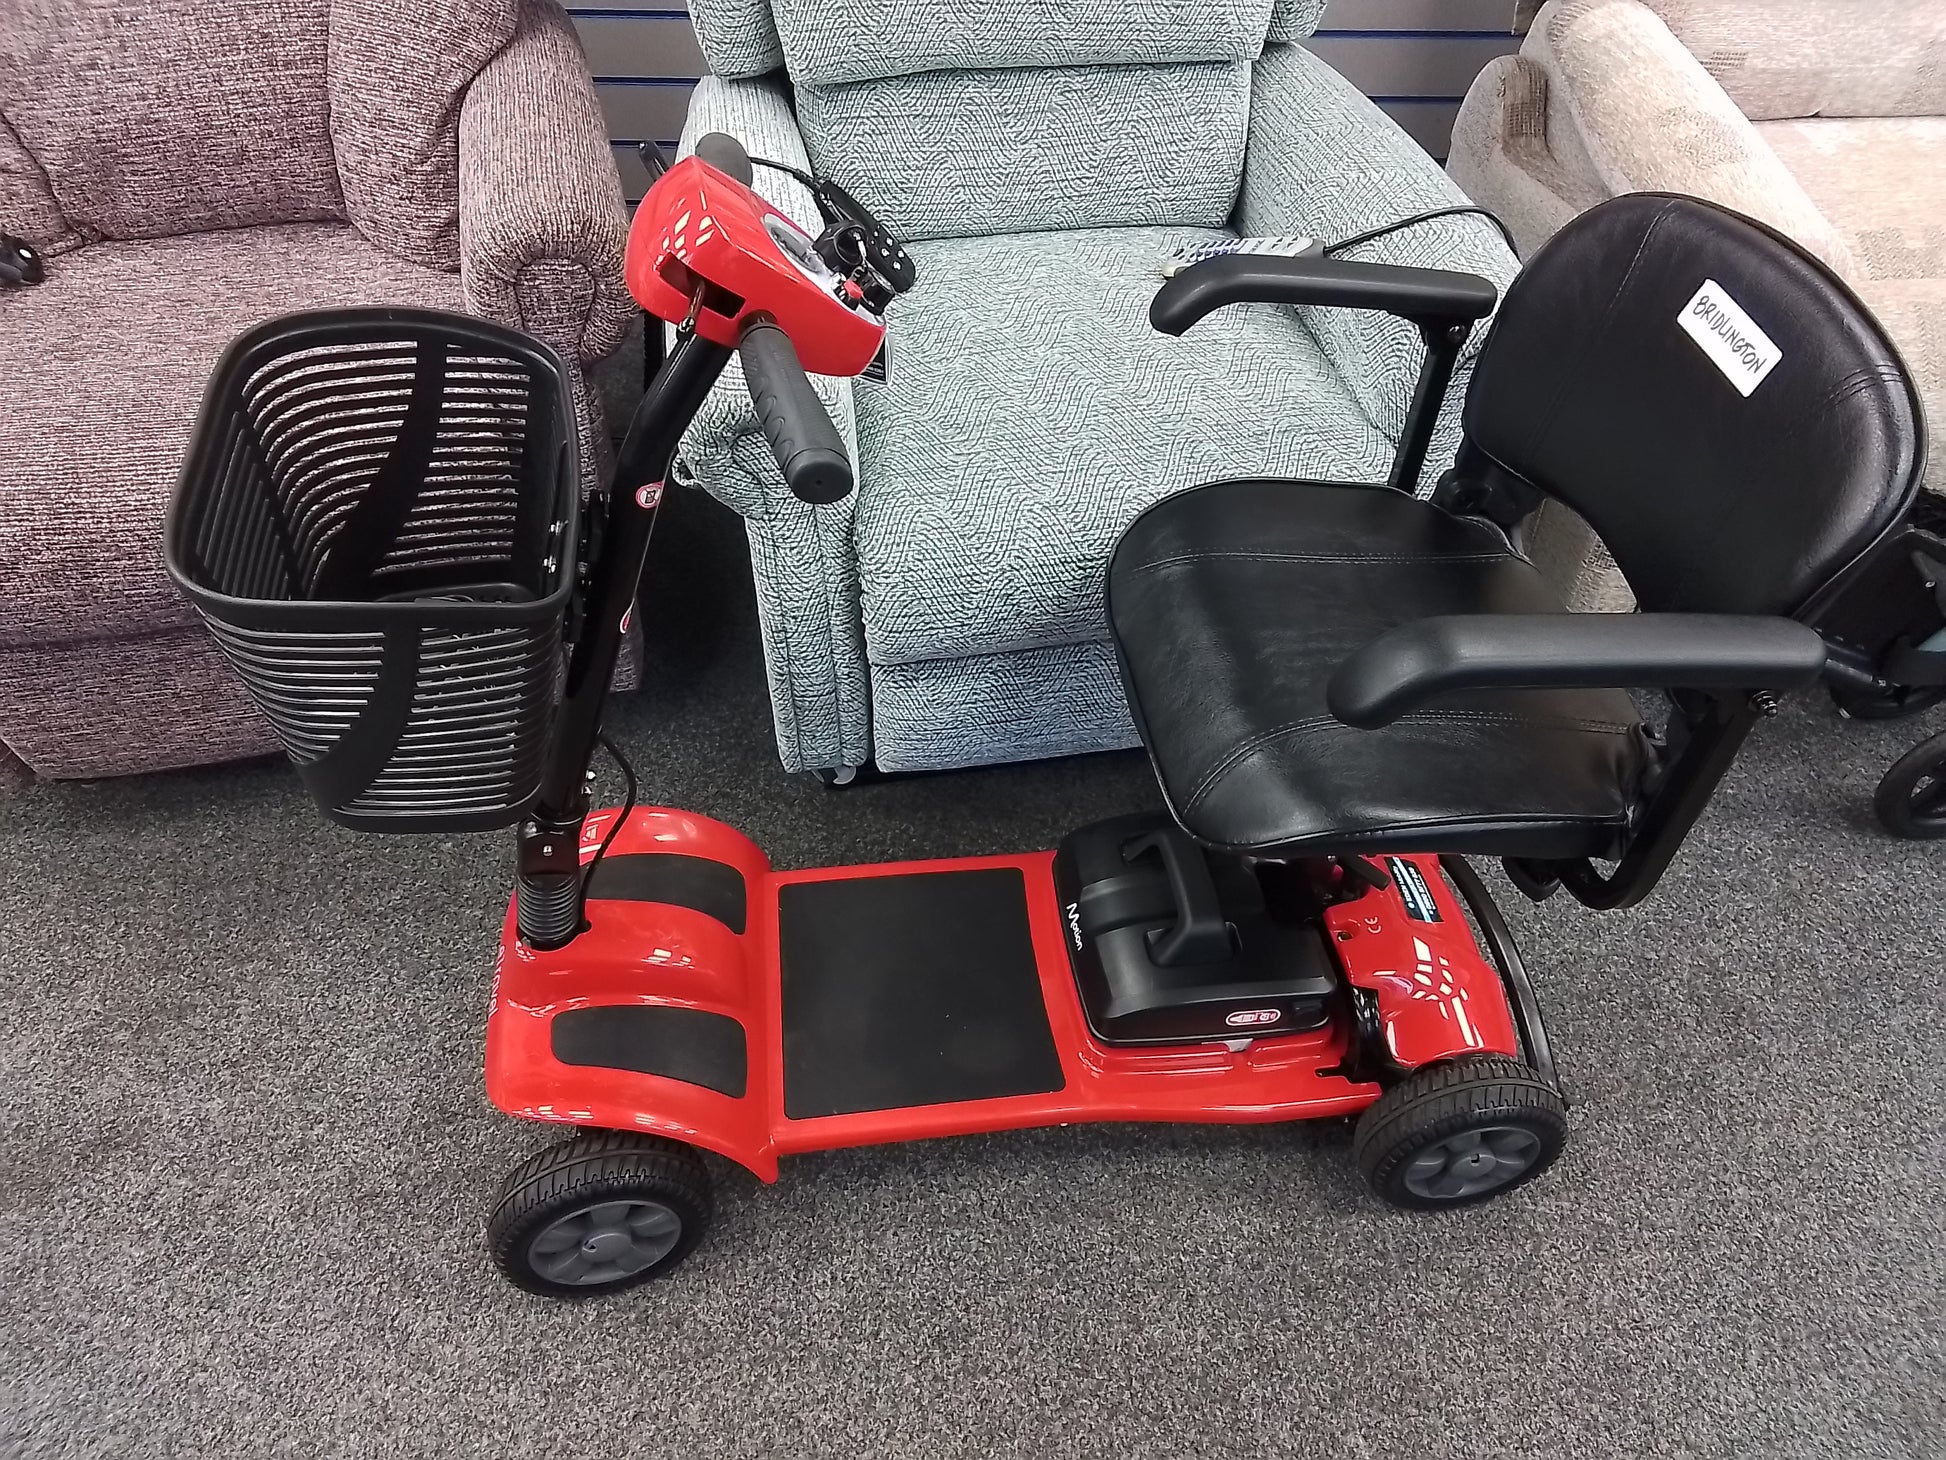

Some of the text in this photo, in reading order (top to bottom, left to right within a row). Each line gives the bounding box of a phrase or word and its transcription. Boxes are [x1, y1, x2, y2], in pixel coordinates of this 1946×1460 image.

[1692, 295, 1768, 374] BRIDLINGTON
[1066, 902, 1083, 951] Motion
[1364, 916, 1381, 934] CE
